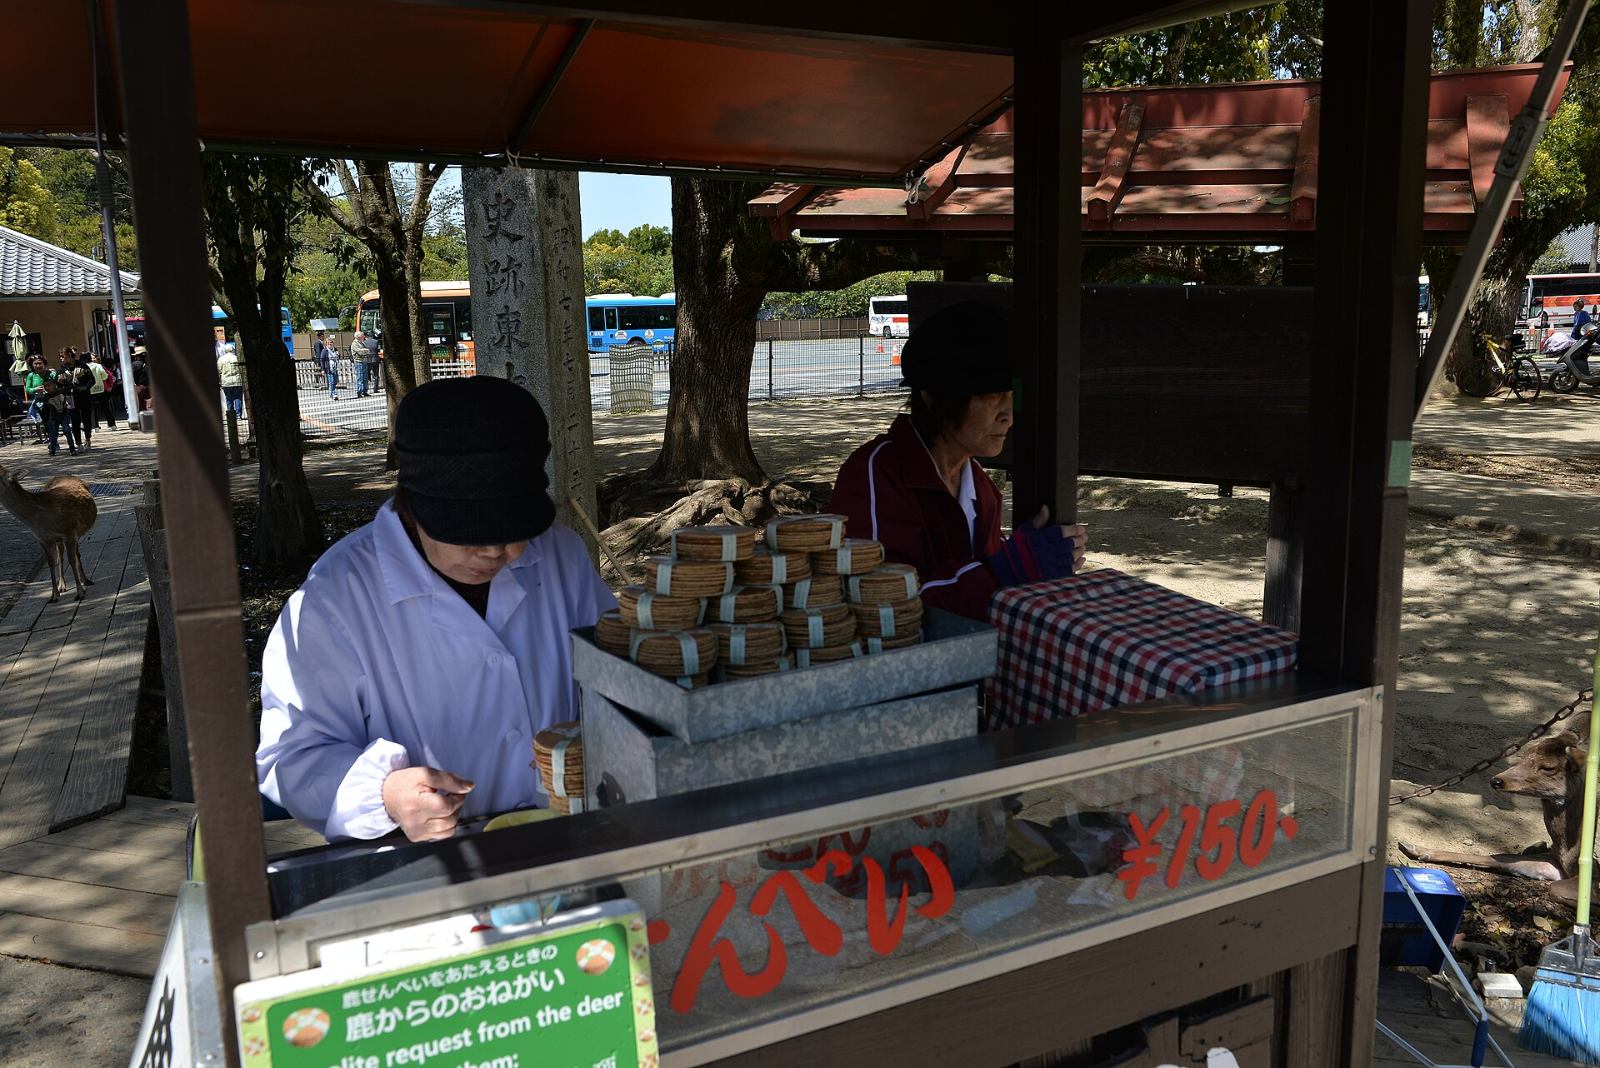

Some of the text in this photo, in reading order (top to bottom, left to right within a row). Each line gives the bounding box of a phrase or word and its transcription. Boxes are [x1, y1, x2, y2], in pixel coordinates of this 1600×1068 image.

[649, 845, 955, 1014] んべい
[342, 944, 557, 1009] 鹿せんべいをあたえるときの
[346, 967, 565, 1042] 鹿からのおねがい
[329, 991, 624, 1068] lite request from the deer
